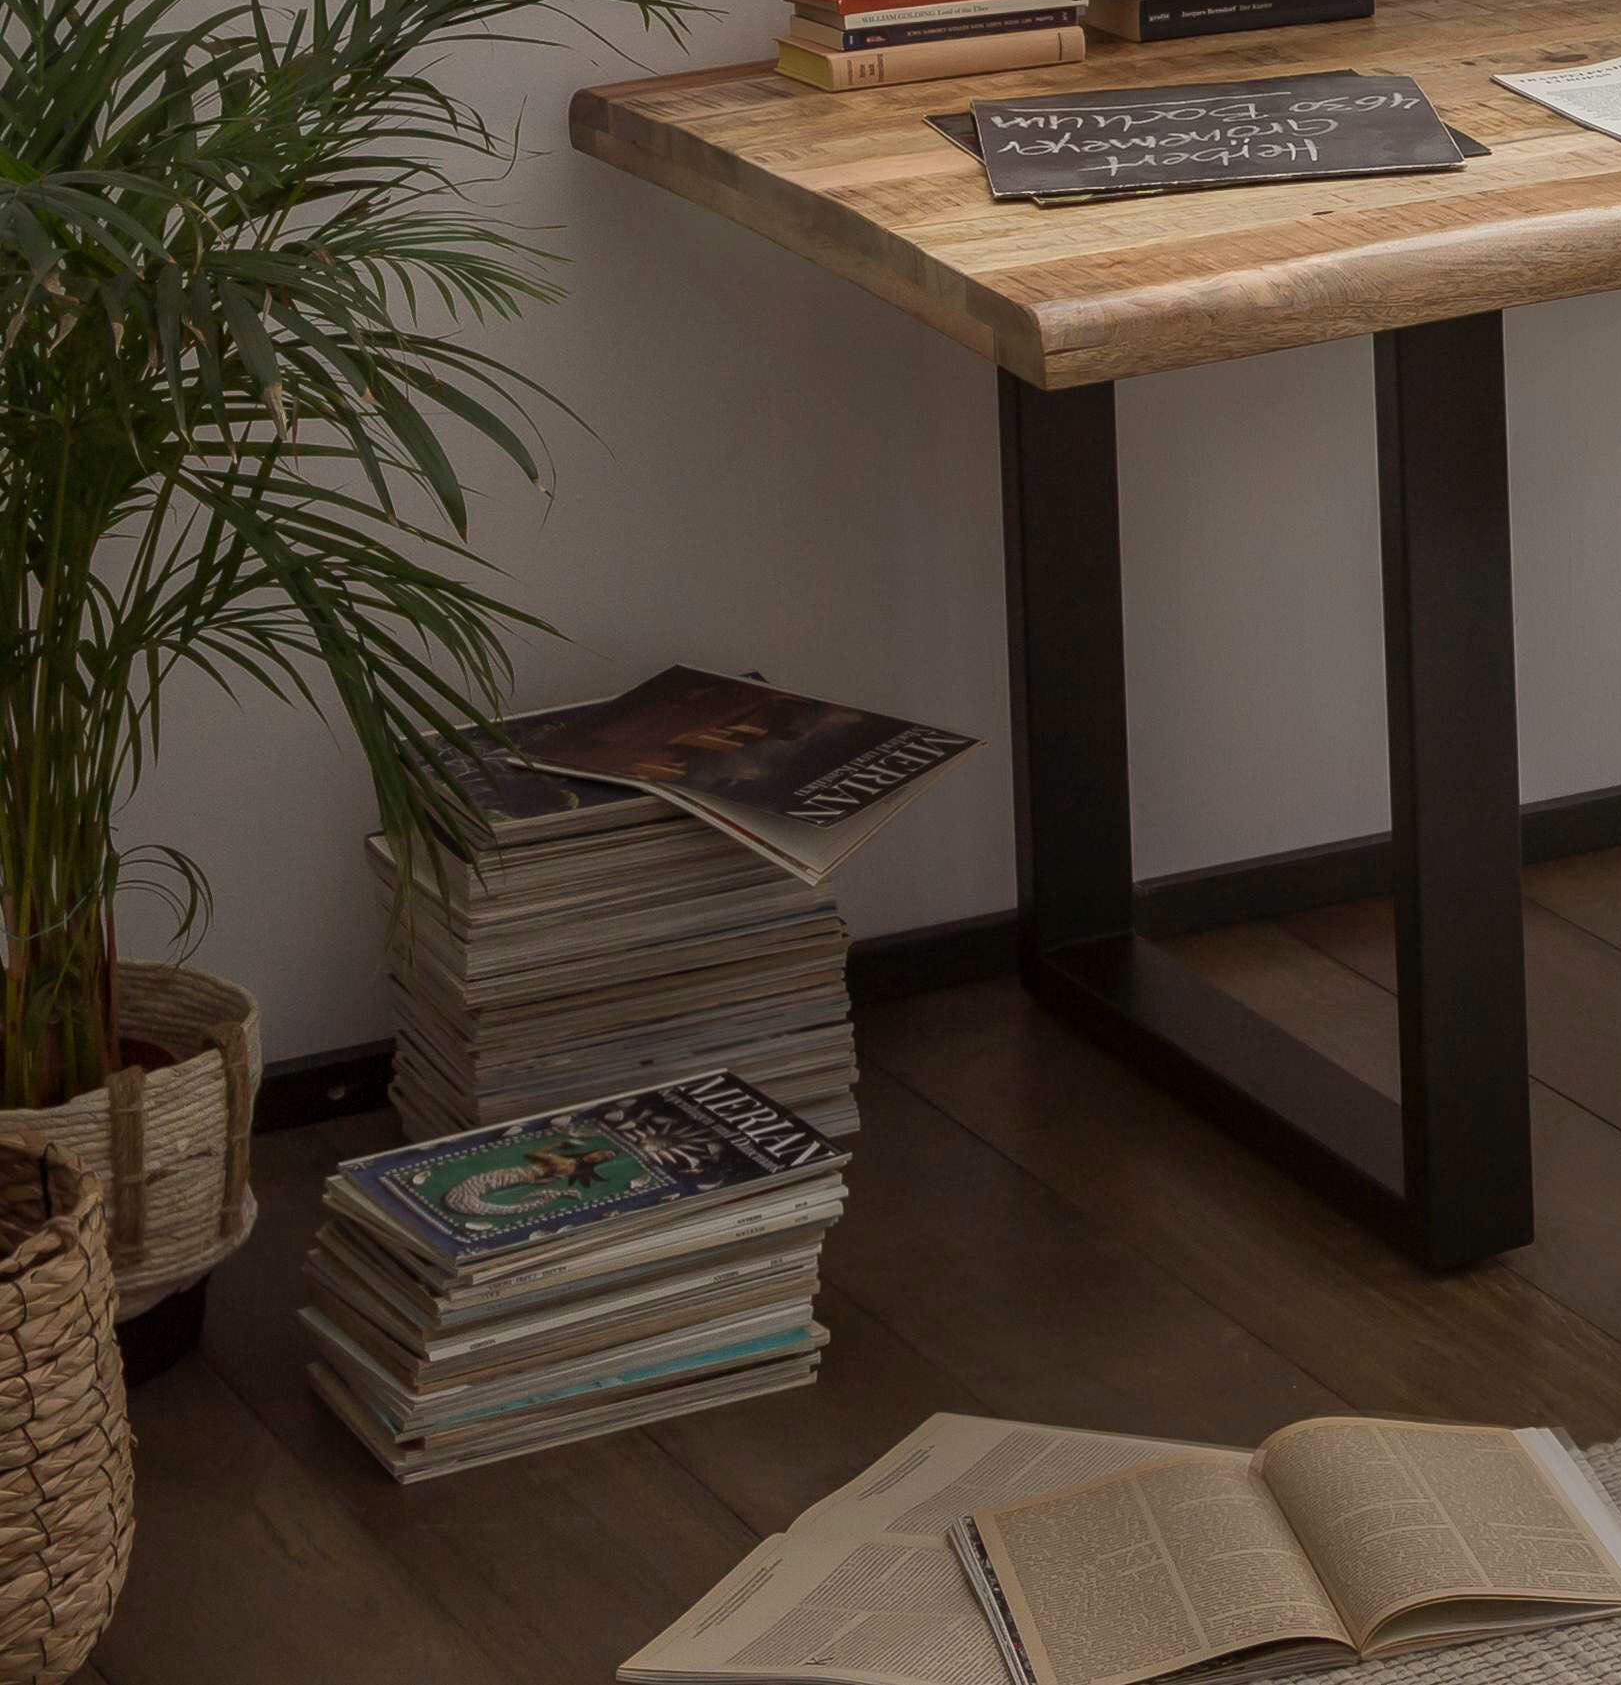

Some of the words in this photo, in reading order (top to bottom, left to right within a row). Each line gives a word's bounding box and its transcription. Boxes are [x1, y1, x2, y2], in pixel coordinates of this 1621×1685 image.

[861, 12, 897, 23] WILLIAM
[991, 102, 1256, 132] Bochum
[1288, 91, 1421, 113] 4630
[998, 118, 1339, 156] Grönemeyer
[1079, 138, 1320, 177] Herbert
[785, 731, 966, 825] MERIAN
[679, 1075, 837, 1166] MERIAN
